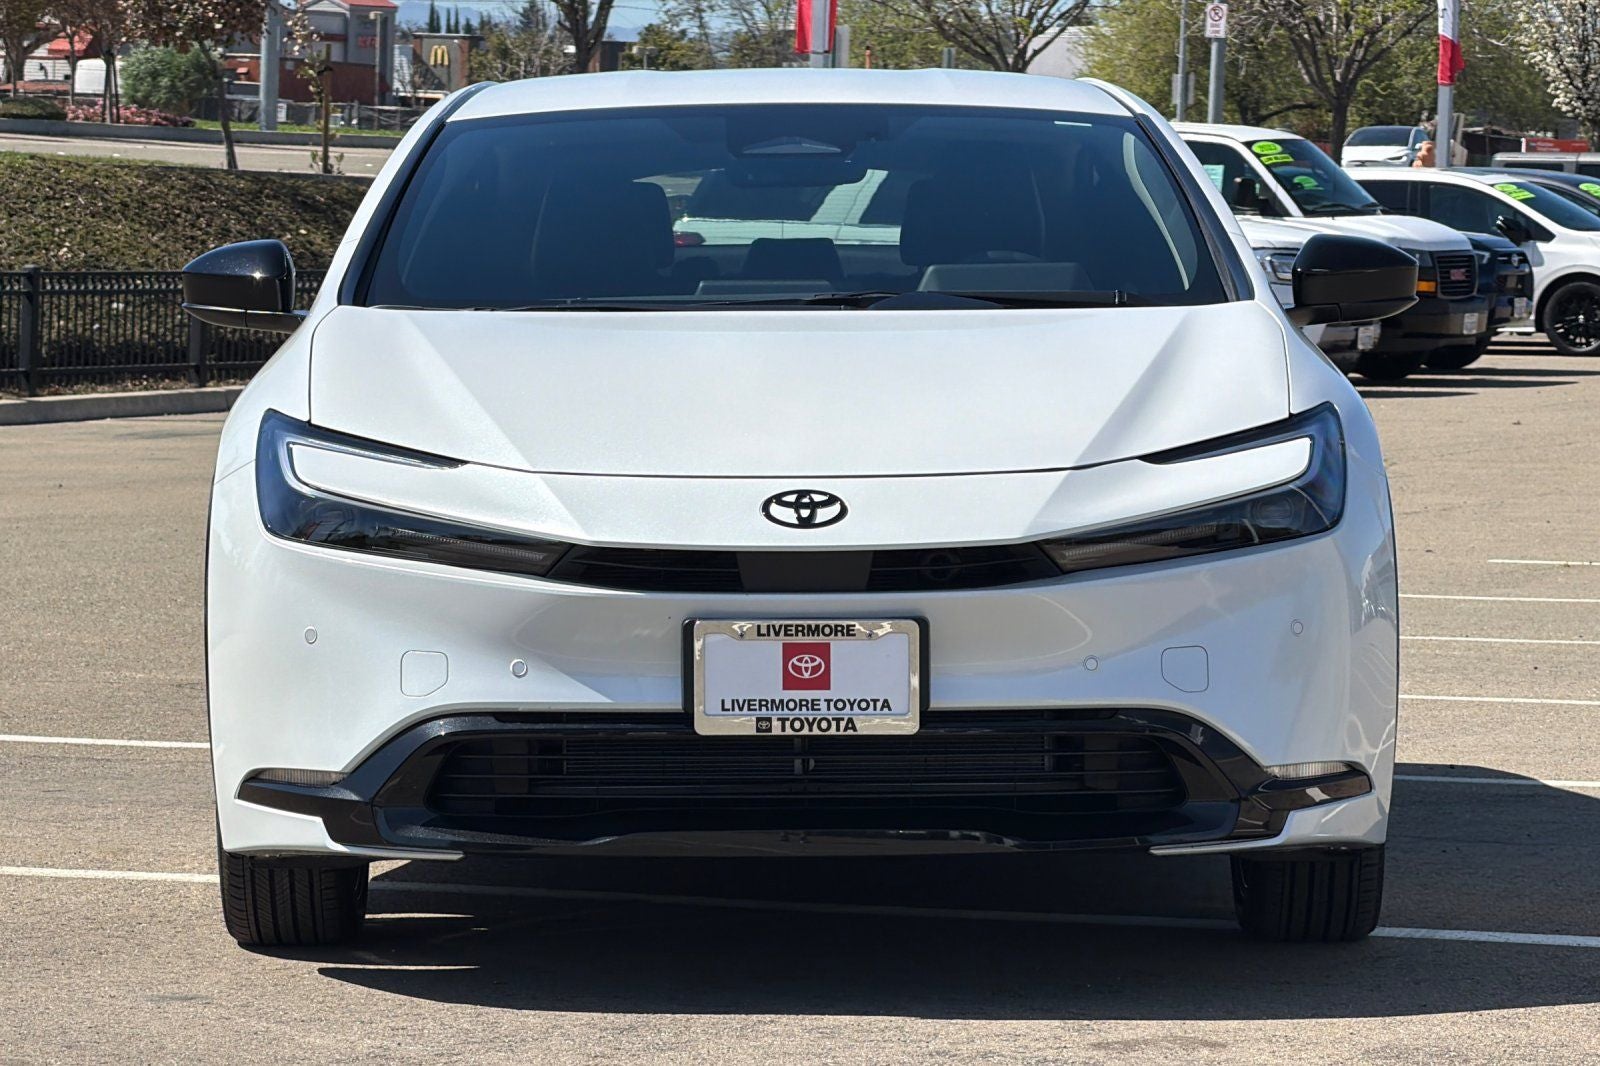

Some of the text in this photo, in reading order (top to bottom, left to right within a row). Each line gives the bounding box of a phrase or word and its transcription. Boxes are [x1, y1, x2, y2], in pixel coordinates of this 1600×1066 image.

[756, 623, 857, 638] LIVERMORE
[720, 698, 893, 712] LIVERMORE TOYOTA
[777, 717, 858, 733] TOYOTA
